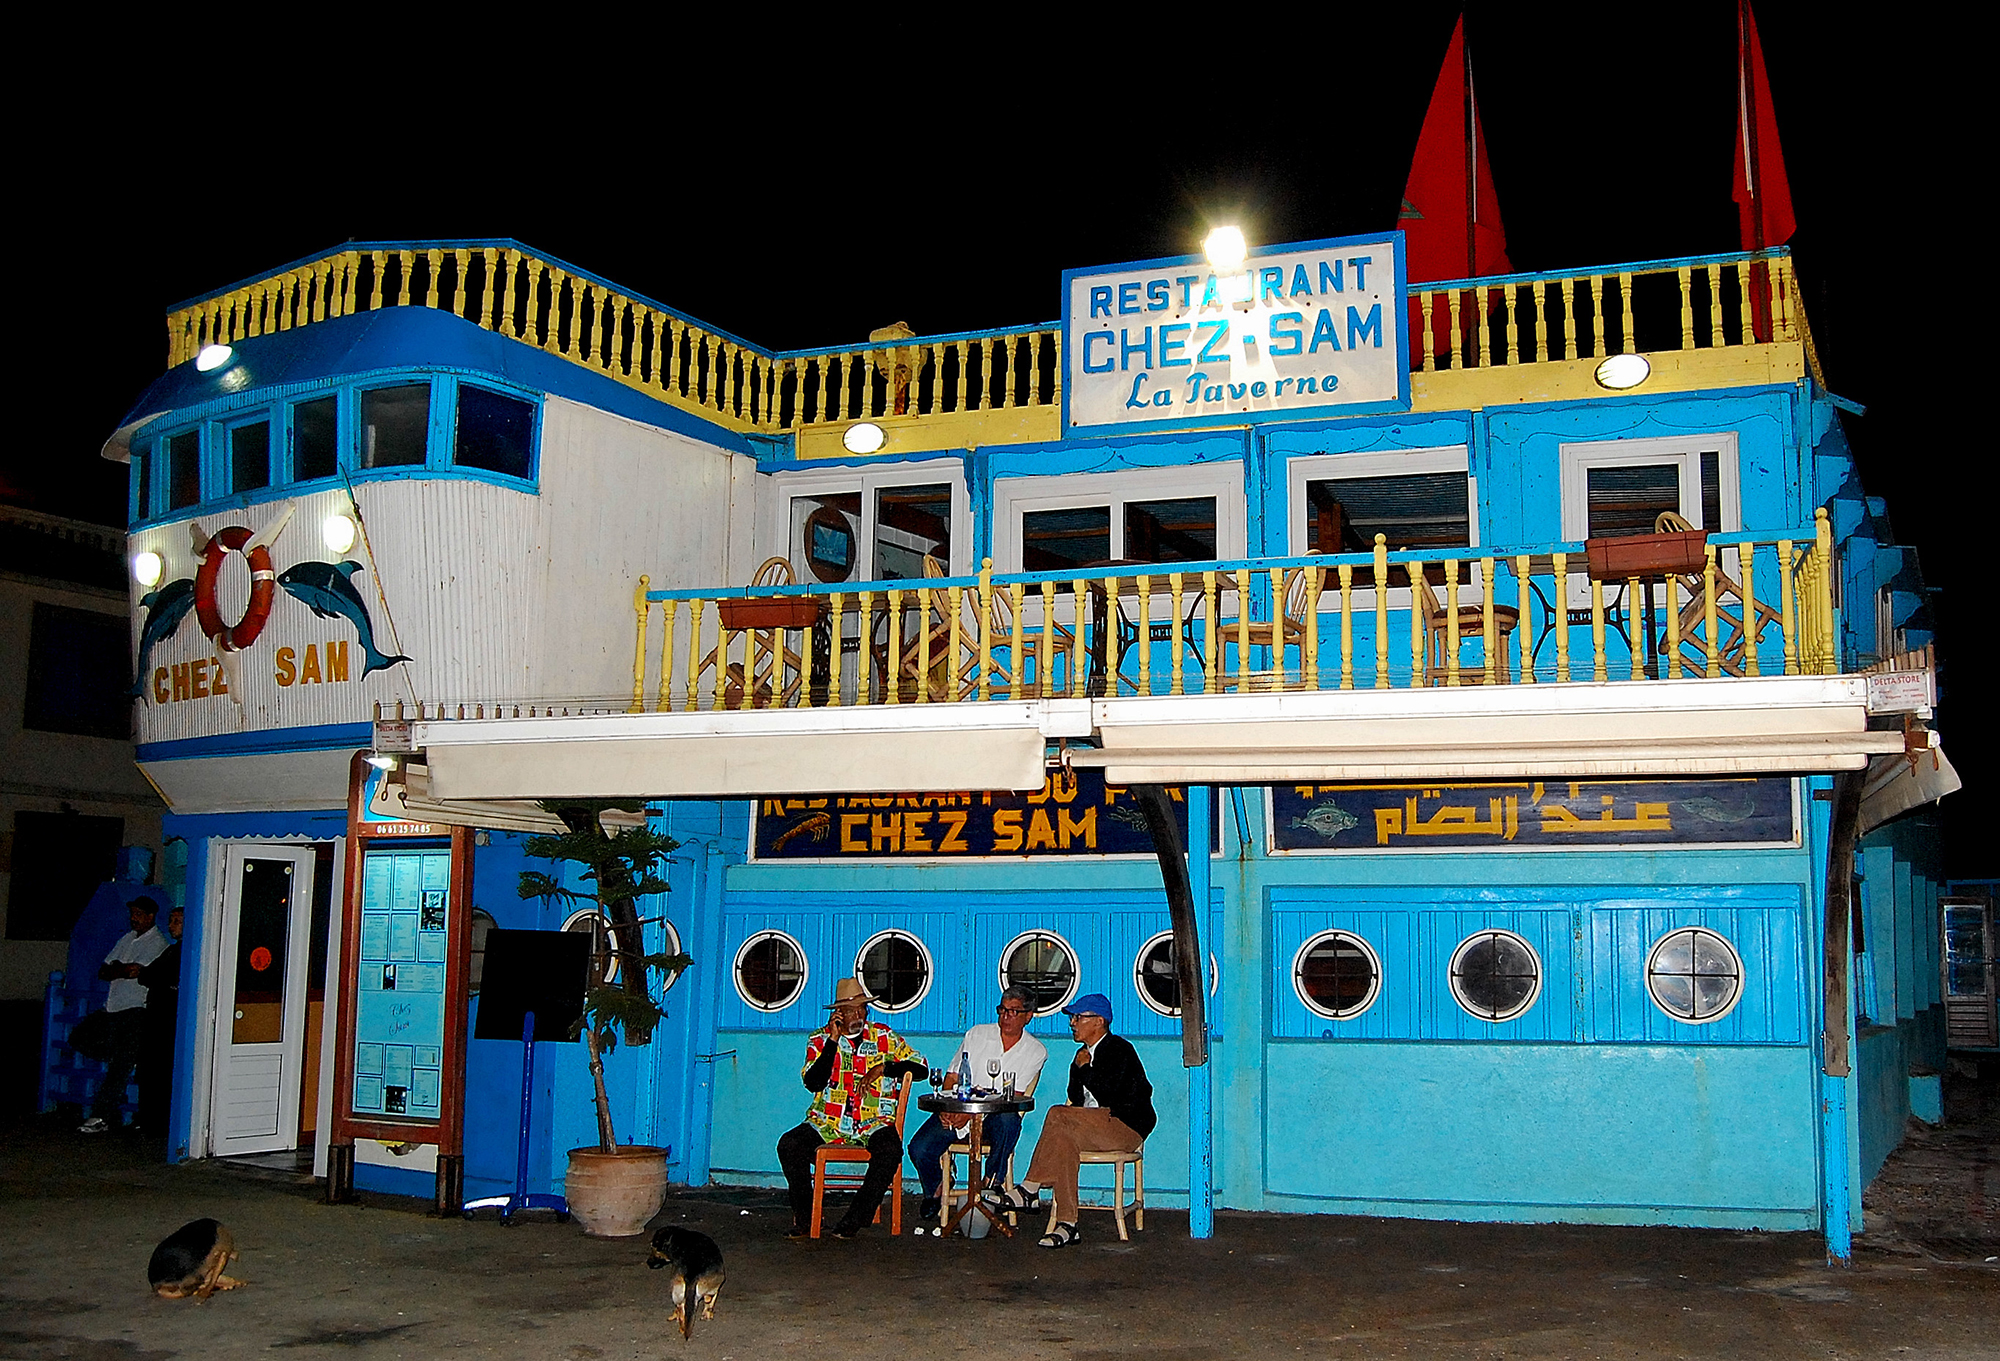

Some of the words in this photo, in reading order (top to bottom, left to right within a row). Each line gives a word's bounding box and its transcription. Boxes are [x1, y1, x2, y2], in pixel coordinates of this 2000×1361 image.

[1090, 256, 1372, 319] RESTAURANT
[1083, 318, 1231, 374] CHEZ
[1269, 303, 1383, 357] SAM
[1125, 372, 1174, 409] La
[1186, 371, 1339, 405] Taverne
[153, 657, 229, 704] CHEZ
[275, 640, 349, 687] SAM
[1874, 677, 1896, 686] DELTA
[1897, 675, 1920, 684] STORE
[410, 824, 419, 834] 74
[840, 811, 969, 853] CHEZ
[991, 804, 1097, 852] SAM
